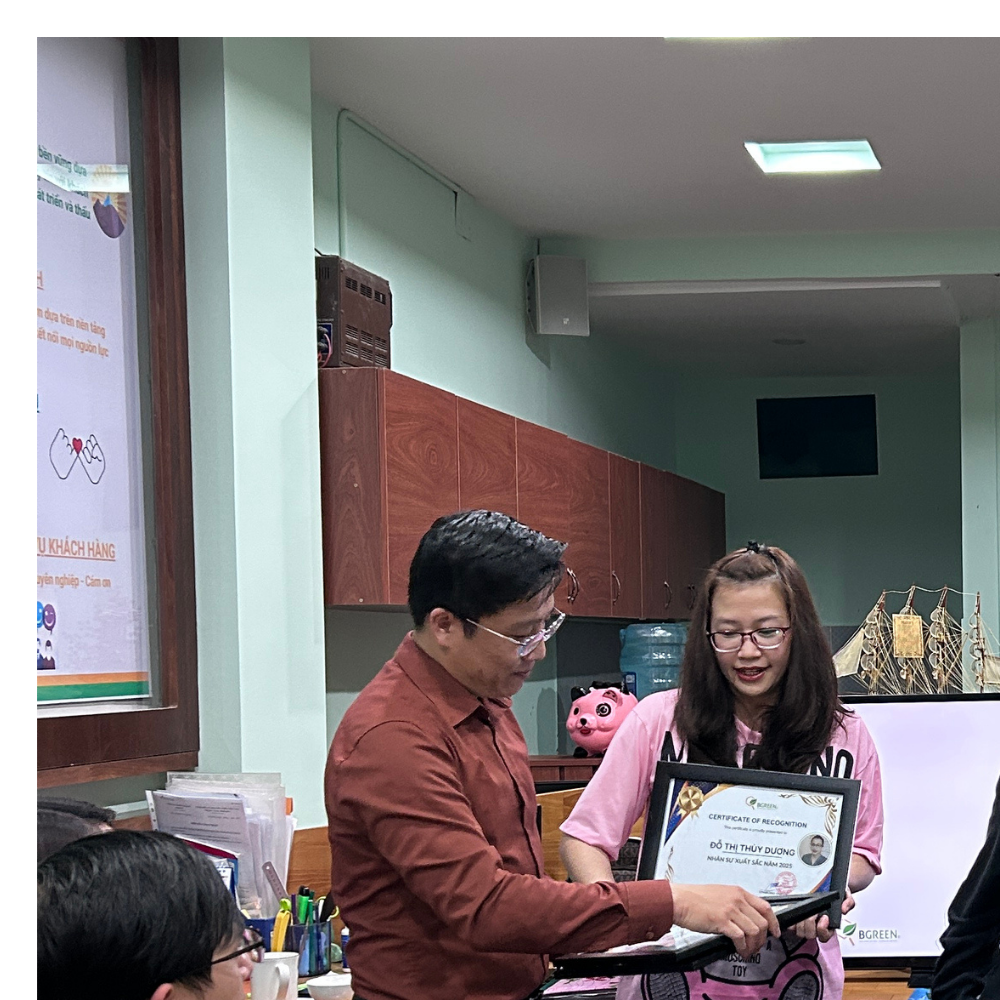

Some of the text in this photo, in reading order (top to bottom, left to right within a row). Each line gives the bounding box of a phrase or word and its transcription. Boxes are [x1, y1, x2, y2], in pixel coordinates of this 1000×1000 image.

[38, 144, 53, 162] bền
[46, 192, 64, 209] triển
[65, 200, 74, 213] và
[60, 312, 75, 327] trên
[48, 535, 85, 557] KHÁCH
[87, 538, 116, 559] HÀNG
[708, 813, 750, 824] CERTIFICATE
[762, 818, 807, 829] RECOGNITION
[725, 842, 738, 853] THỊ
[764, 846, 796, 857] DƯƠNG
[858, 929, 898, 940] BGREEN
[732, 965, 747, 978] TOY
